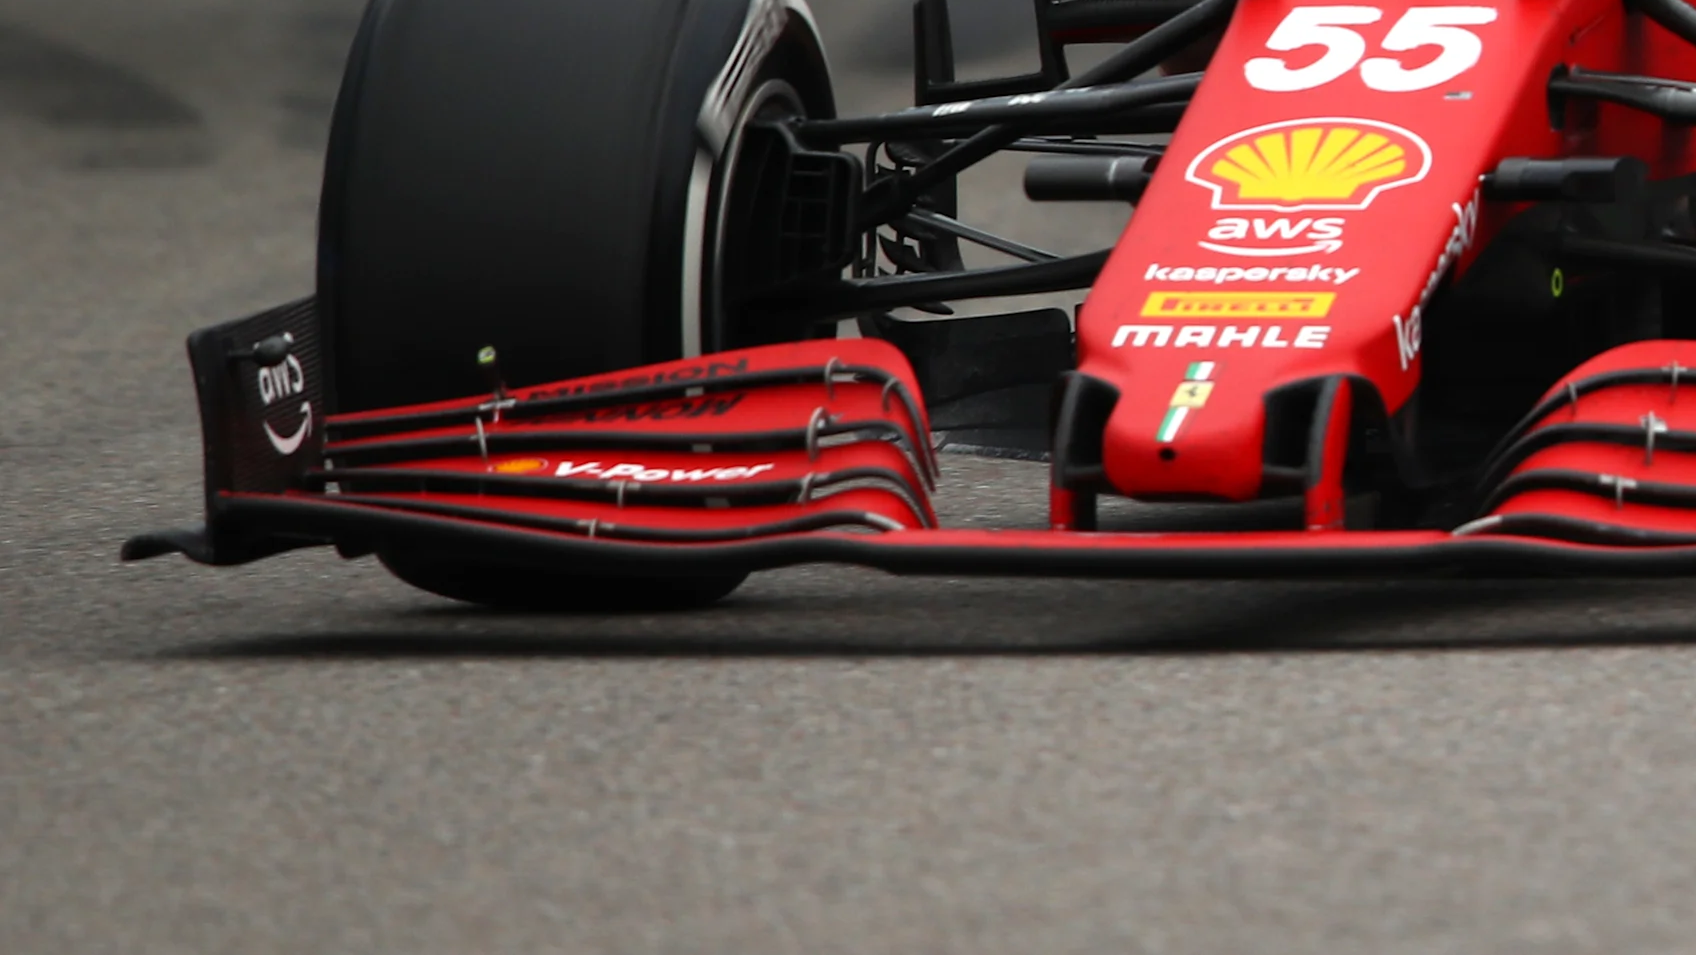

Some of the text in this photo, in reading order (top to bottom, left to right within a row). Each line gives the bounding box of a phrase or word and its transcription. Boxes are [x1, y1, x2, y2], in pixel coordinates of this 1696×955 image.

[1245, 6, 1497, 91] 55
[1207, 218, 1346, 240] aws
[1144, 263, 1360, 284] kaspersky
[1160, 298, 1315, 312] PIRELLI
[1112, 325, 1331, 348] MAHLE
[555, 461, 774, 481] V-Power
